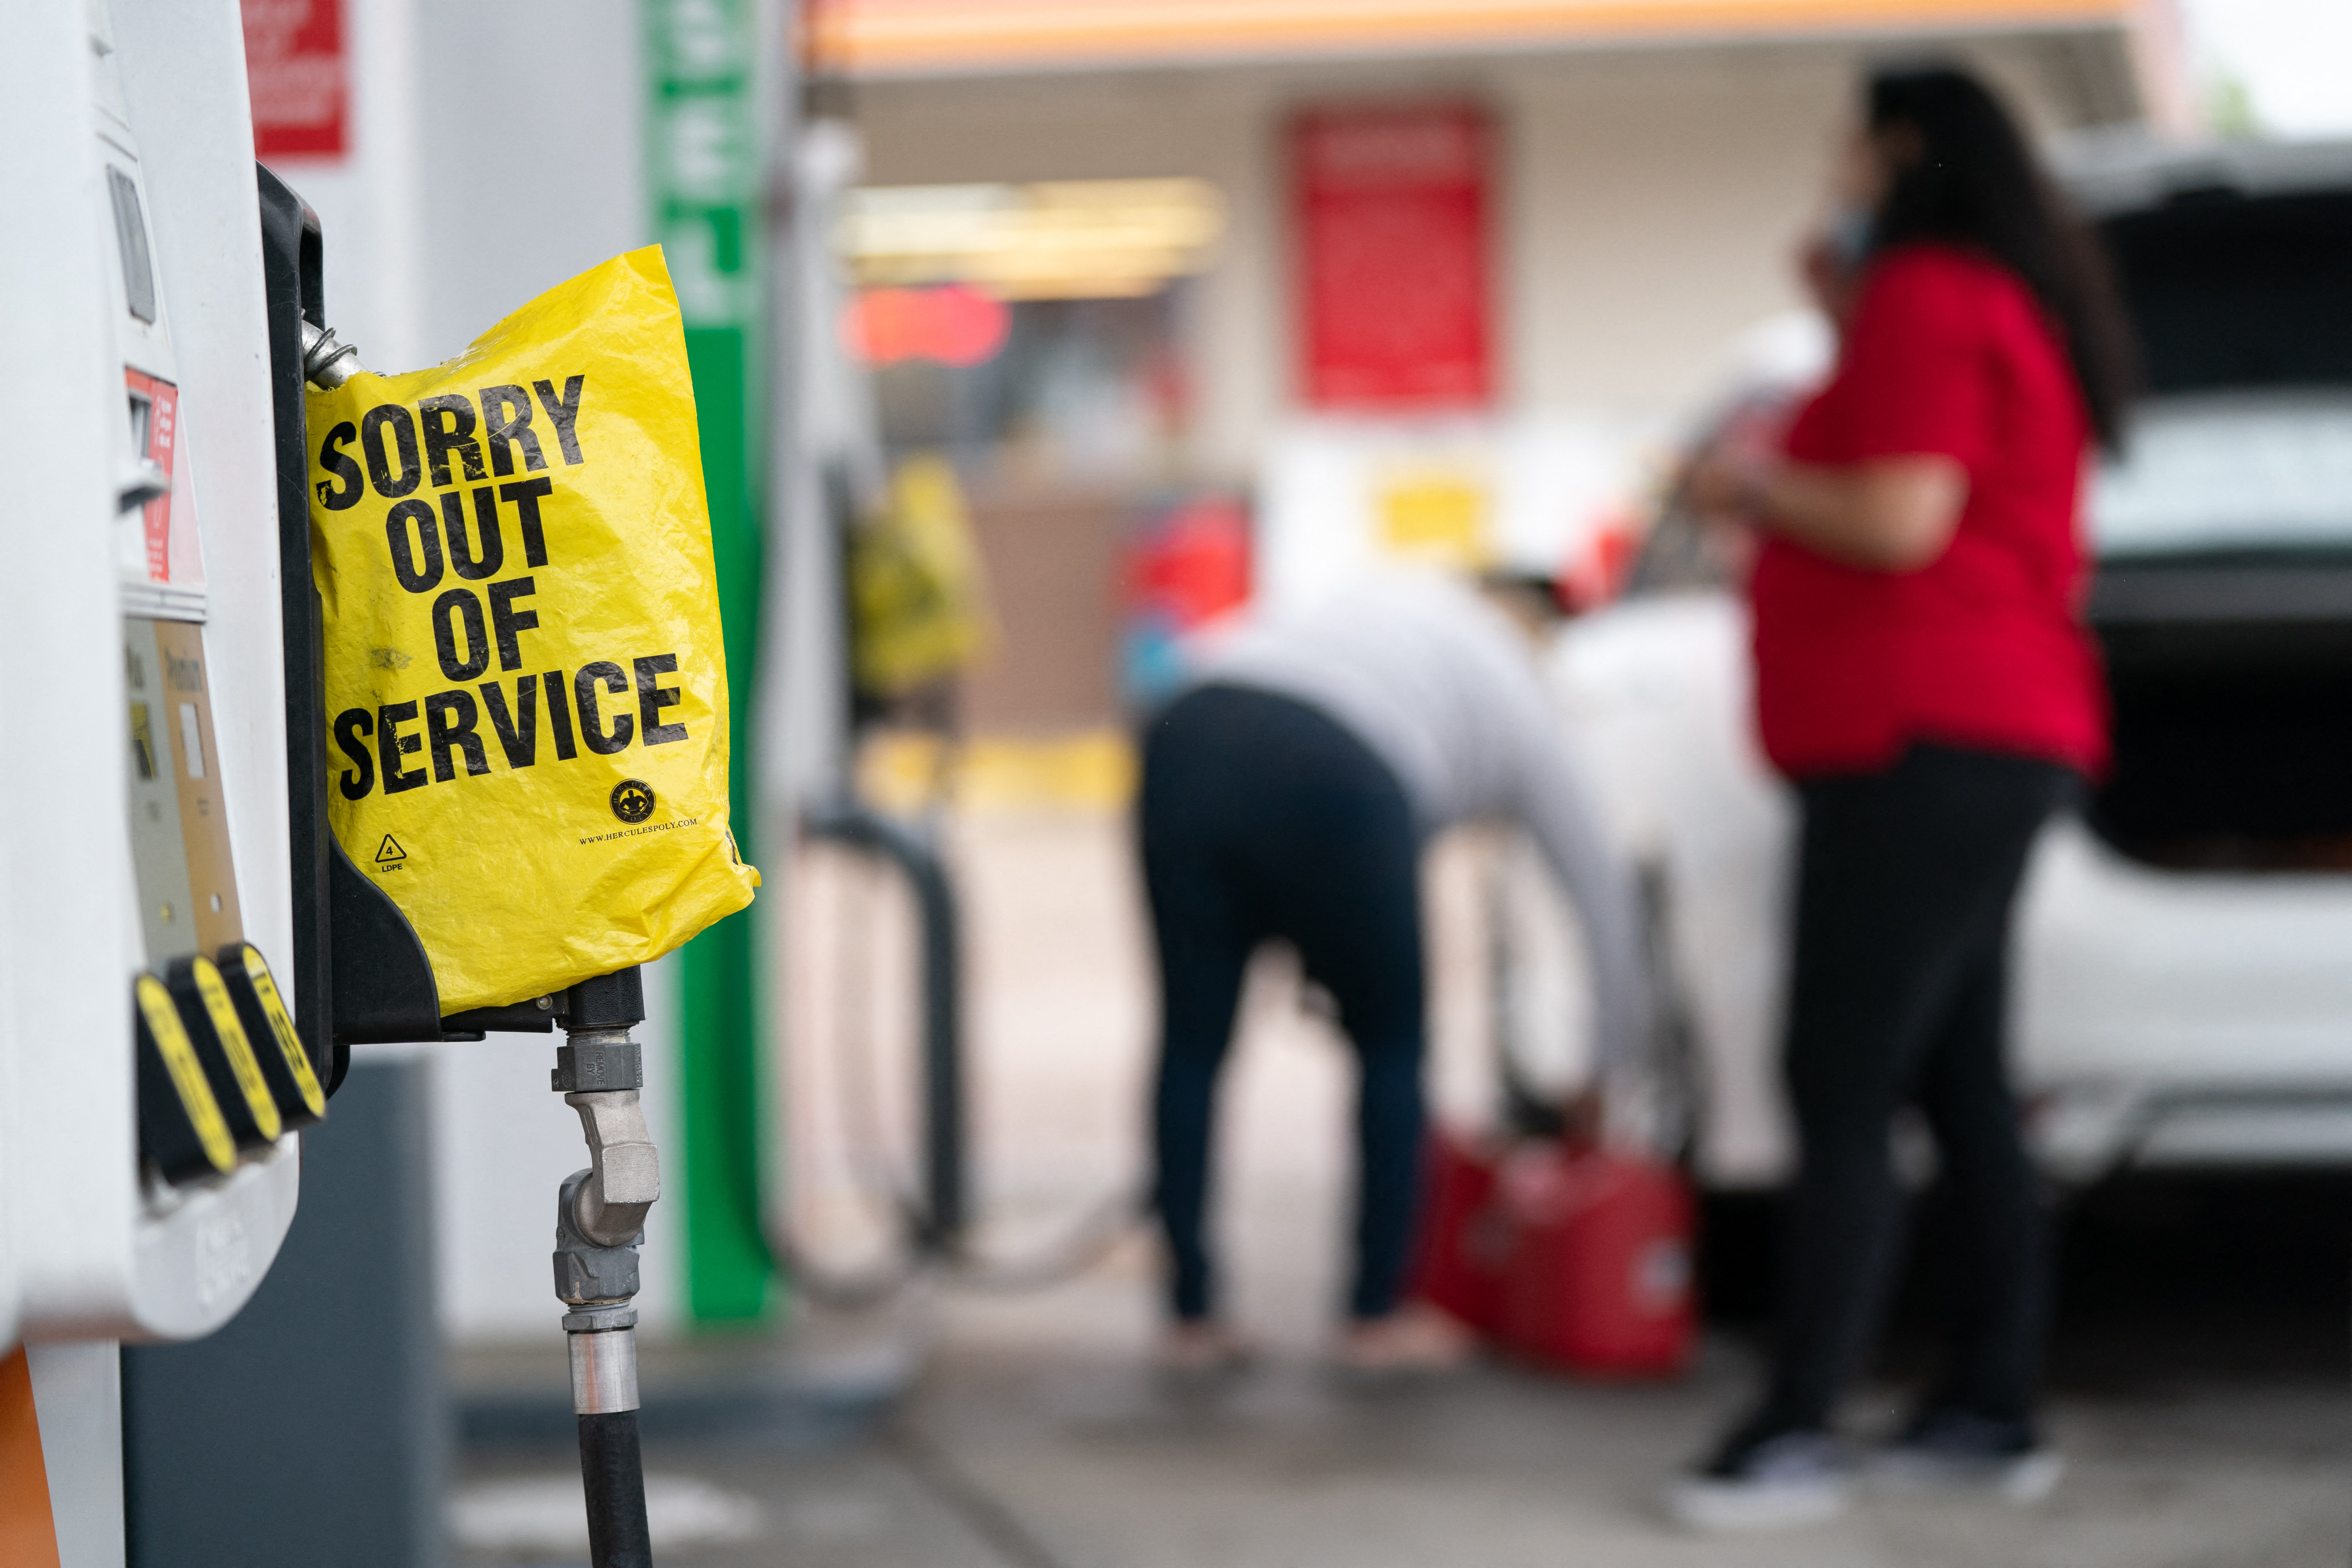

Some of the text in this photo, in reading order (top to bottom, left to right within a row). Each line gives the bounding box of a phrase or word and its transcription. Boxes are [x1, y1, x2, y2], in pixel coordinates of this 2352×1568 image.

[316, 374, 585, 511] SORRY
[386, 477, 552, 593] OUT
[432, 576, 539, 682] OF
[333, 653, 688, 801] SERVICE
[579, 818, 697, 845] WWW.HERCULESPOLY.COM
[386, 846, 393, 855] 4
[382, 864, 403, 872] LDPE
[586, 1063, 595, 1074] BY
[595, 1051, 605, 1085] REMOVE
